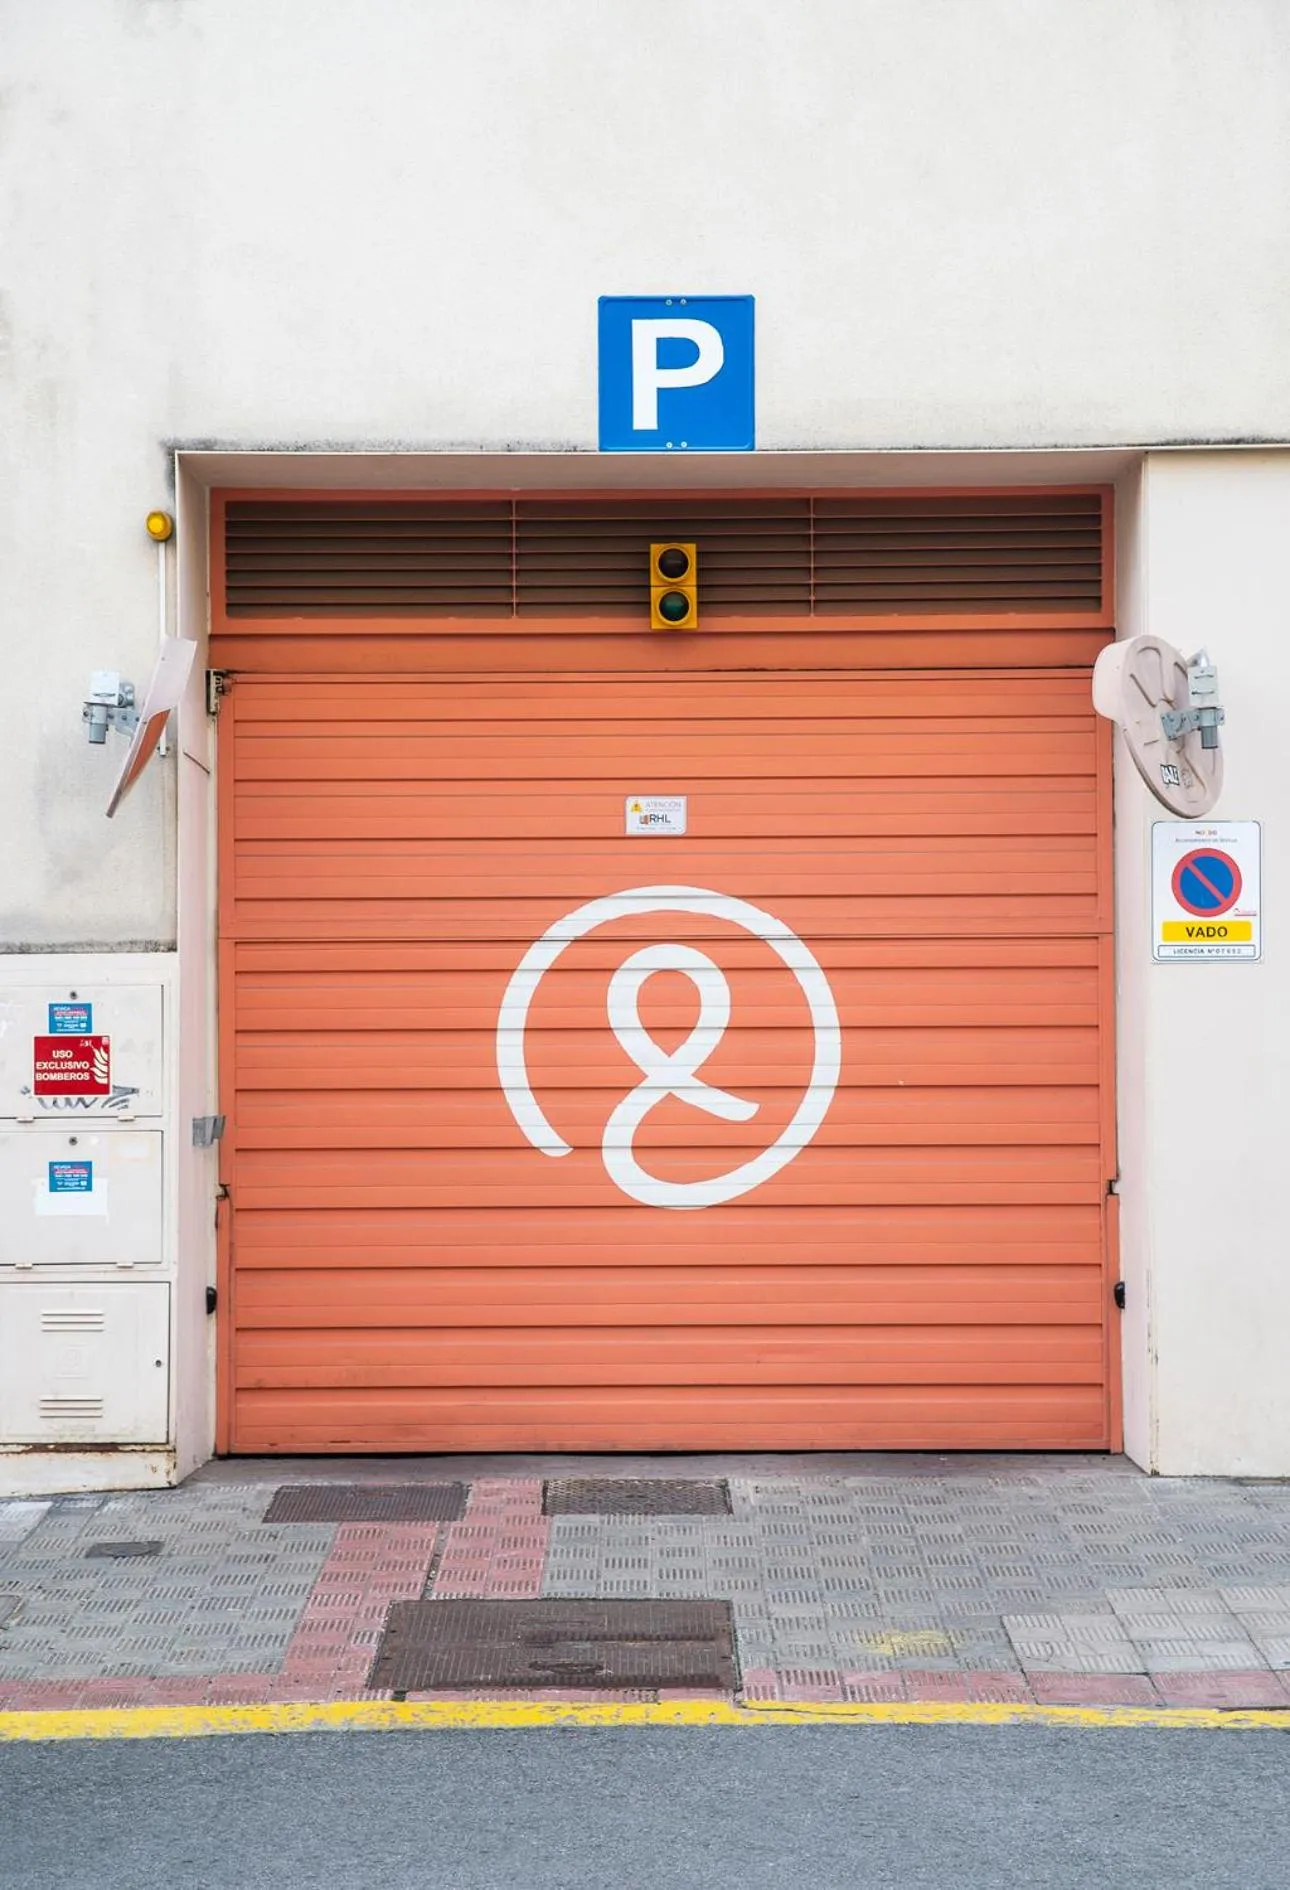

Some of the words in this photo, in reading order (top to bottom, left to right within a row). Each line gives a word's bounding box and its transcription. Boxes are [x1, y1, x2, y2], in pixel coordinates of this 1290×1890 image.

[631, 318, 725, 431] P
[1185, 925, 1228, 938] VADO
[52, 1049, 74, 1059] USO
[35, 1060, 90, 1071] EXCLUSIVO
[35, 1072, 90, 1082] BOMBEROS
